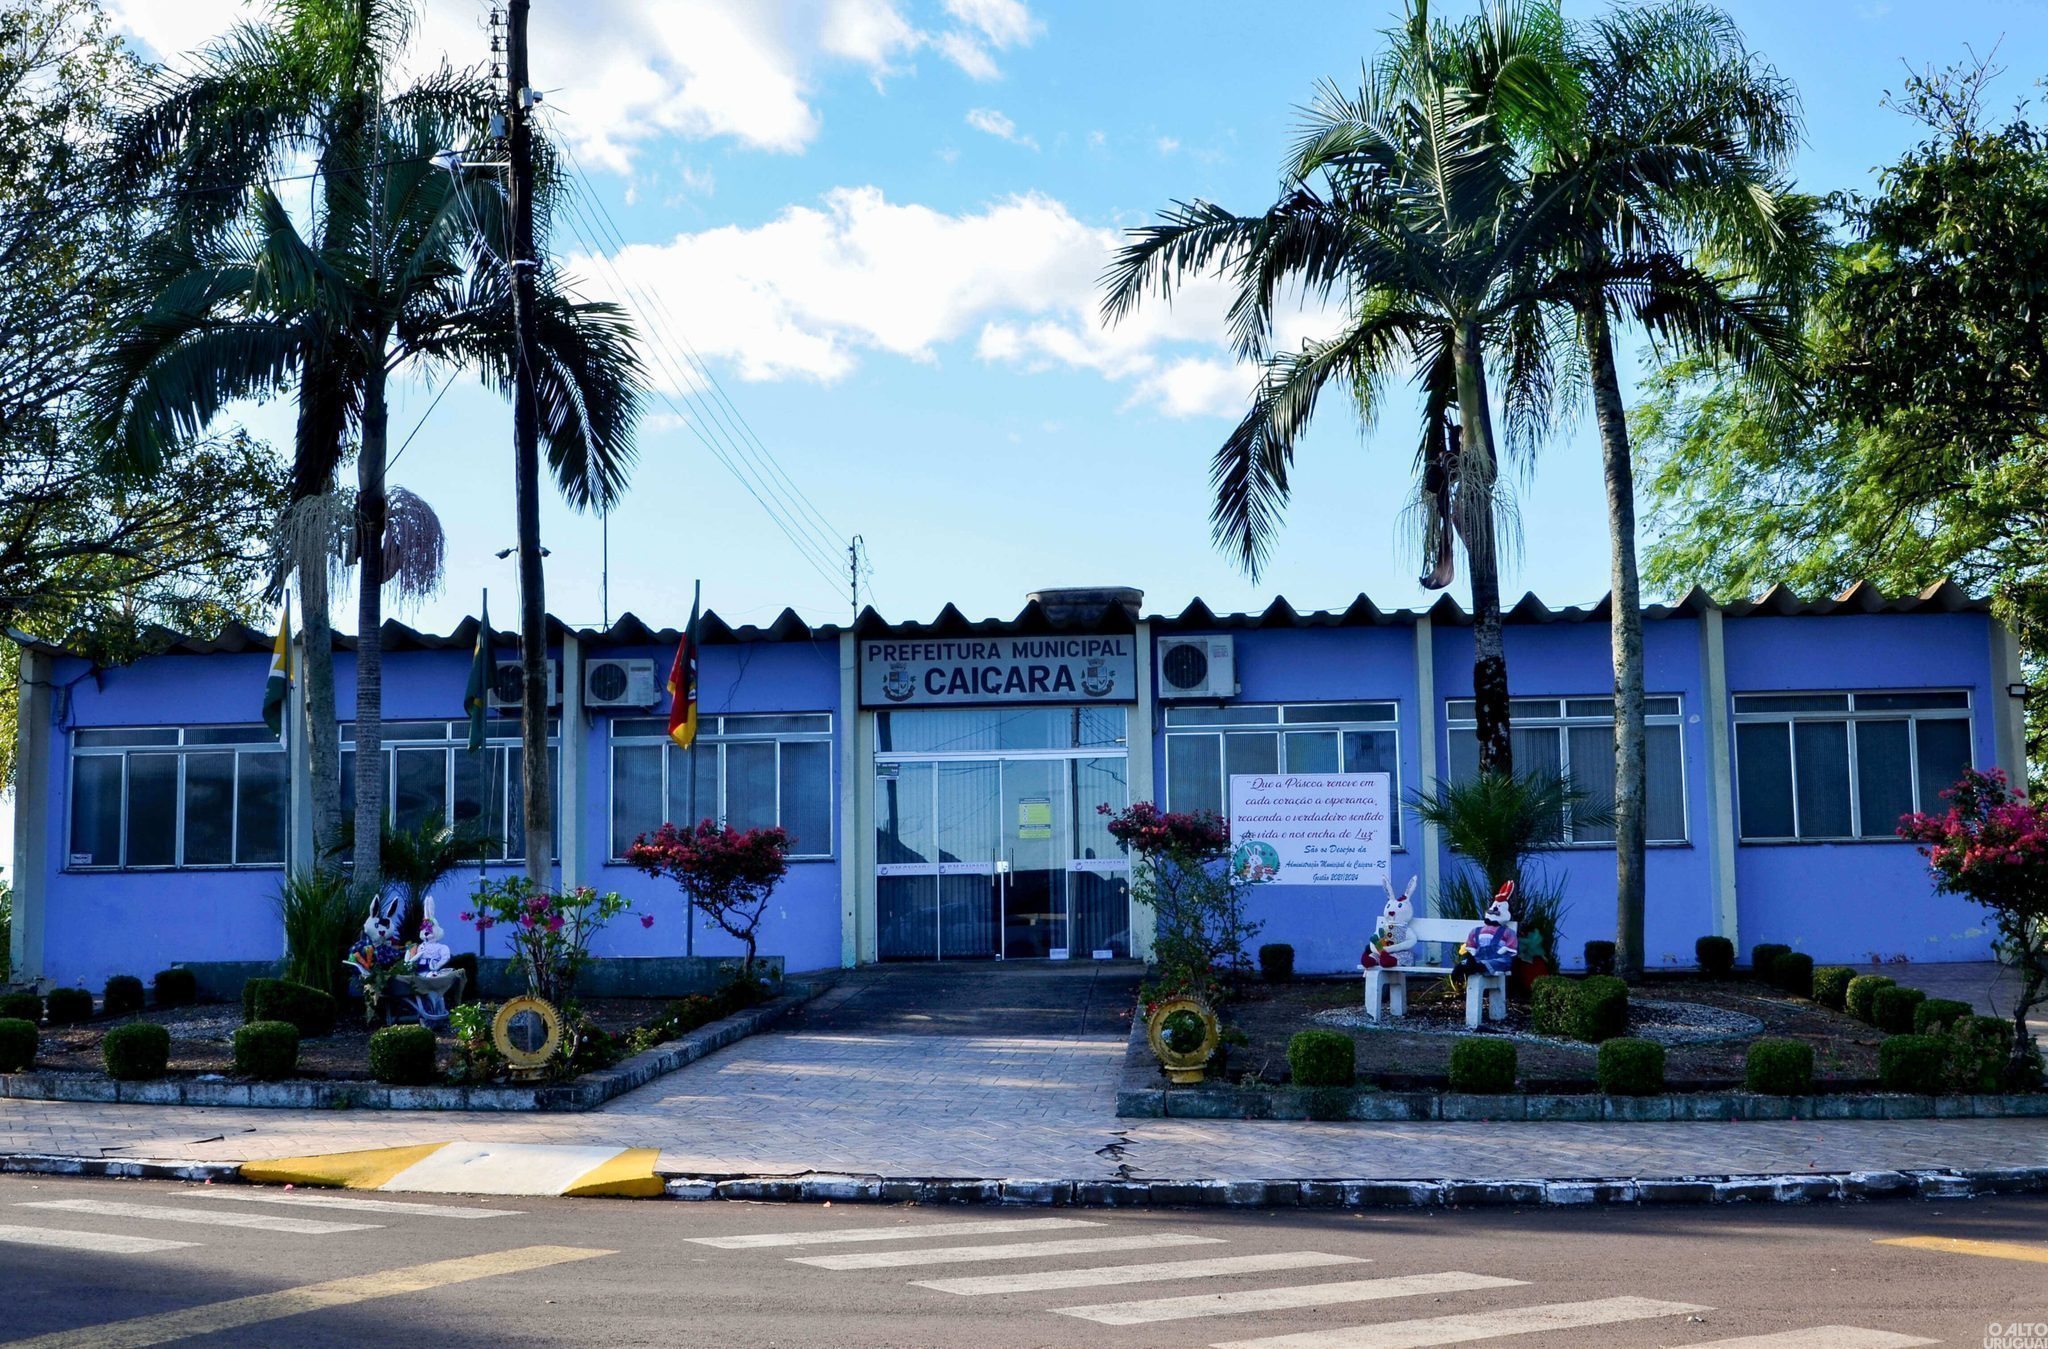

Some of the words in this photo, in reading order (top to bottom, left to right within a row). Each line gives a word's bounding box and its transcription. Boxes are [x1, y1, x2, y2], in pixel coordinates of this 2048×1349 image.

[868, 642, 1001, 662] PREFEITURA
[1012, 639, 1127, 659] MUNICIPAL
[924, 665, 1076, 695] CAIÇARA
[1284, 777, 1323, 789] Páscoa
[1326, 780, 1358, 788] renove
[1245, 796, 1270, 806] cada
[1273, 796, 1312, 807] coração
[1314, 797, 1322, 805] a
[1237, 812, 1282, 822] reacenda
[1292, 812, 1347, 822] verdadeiro
[1348, 811, 1384, 822] sentido
[1256, 829, 1279, 839] vida
[1281, 831, 1287, 839] e
[1288, 831, 1305, 839] nos
[1306, 828, 1335, 839] encha
[1338, 828, 1352, 839] de
[1303, 845, 1319, 854] São
[1329, 844, 1356, 855] Desejos
[1357, 845, 1367, 853] da
[1285, 860, 1319, 870] Administração
[1320, 860, 1345, 869] Municipal
[1346, 860, 1352, 868] de
[1312, 873, 1330, 883] Gestão
[1331, 873, 1359, 882] 2021/2024
